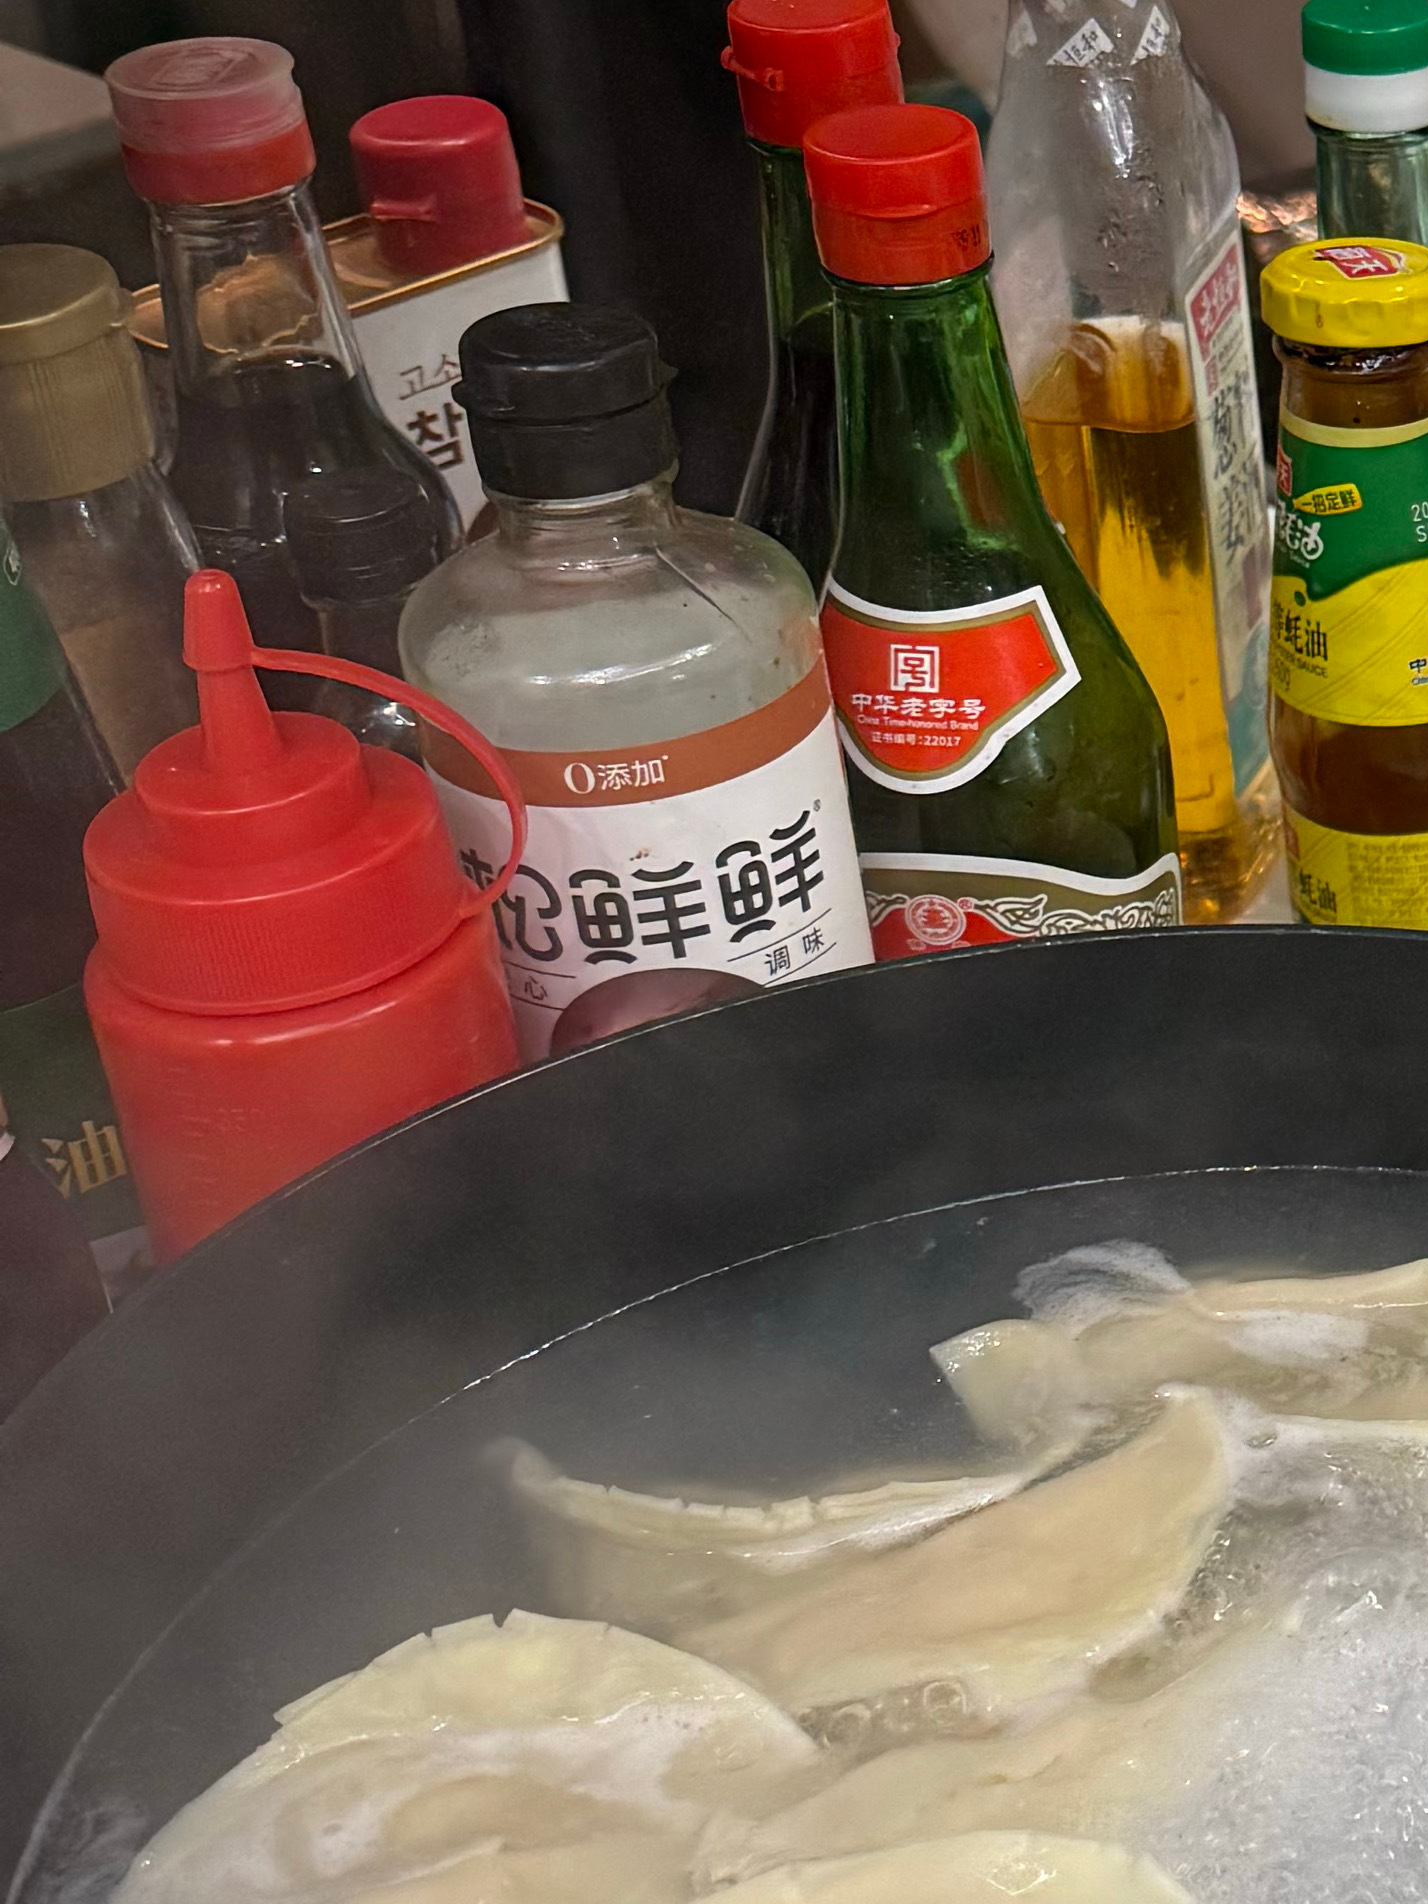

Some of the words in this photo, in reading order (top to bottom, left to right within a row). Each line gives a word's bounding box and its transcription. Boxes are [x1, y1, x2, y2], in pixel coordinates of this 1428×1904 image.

[851, 693, 987, 720] 中华老字号
[764, 926, 827, 977] 调味
[41, 1120, 128, 1199] 油
